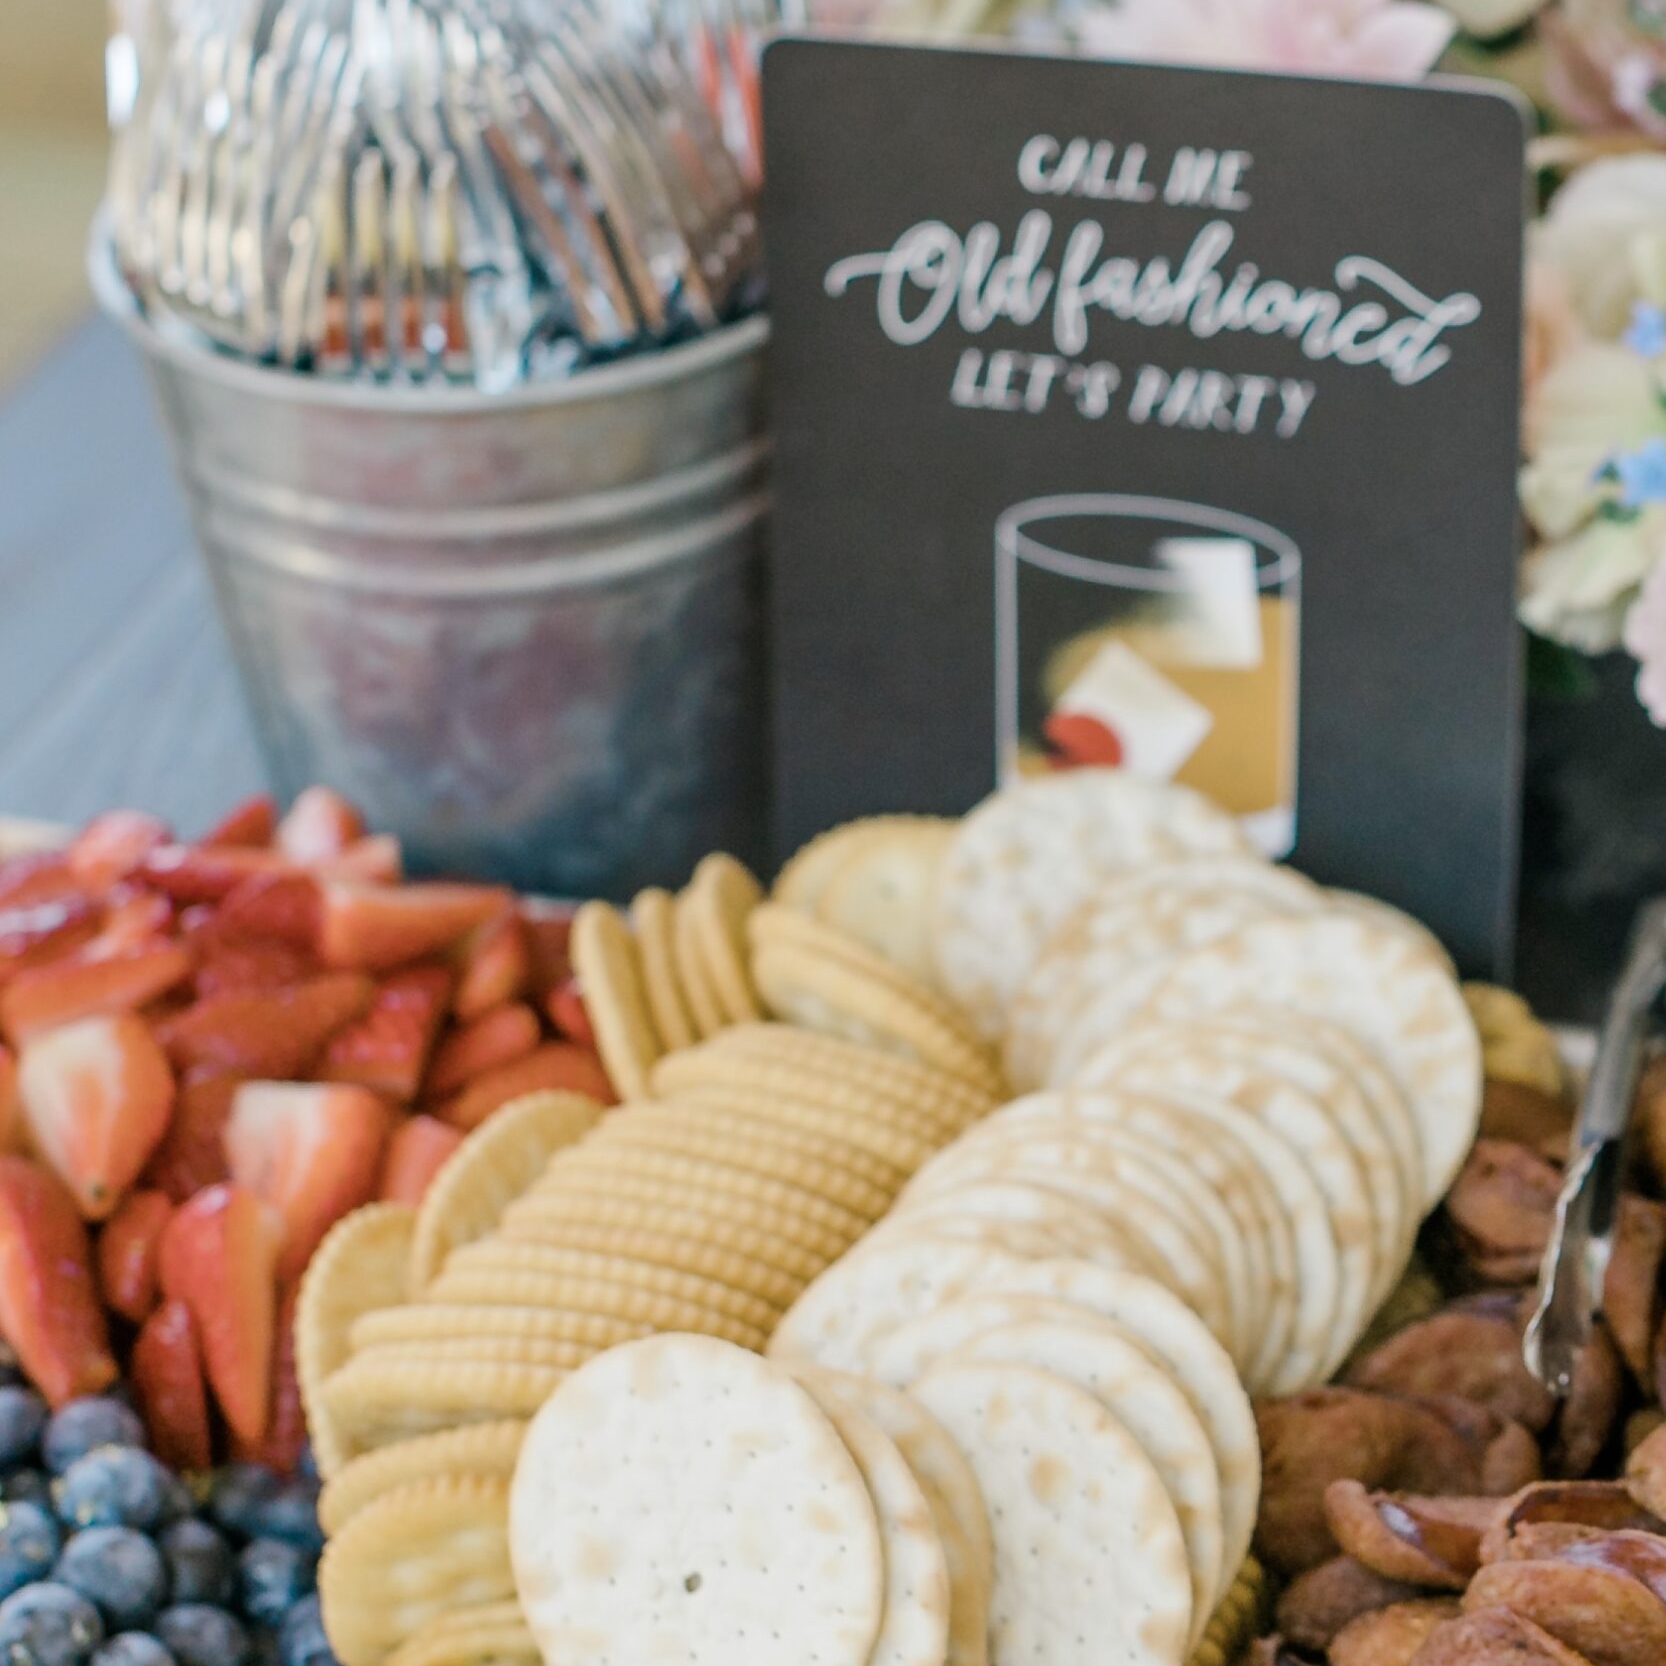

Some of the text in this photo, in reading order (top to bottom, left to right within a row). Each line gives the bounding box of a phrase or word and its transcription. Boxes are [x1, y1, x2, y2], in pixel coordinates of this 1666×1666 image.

[1017, 134, 1252, 210] CALL ME
[951, 347, 1317, 439] LET'S PARTY
